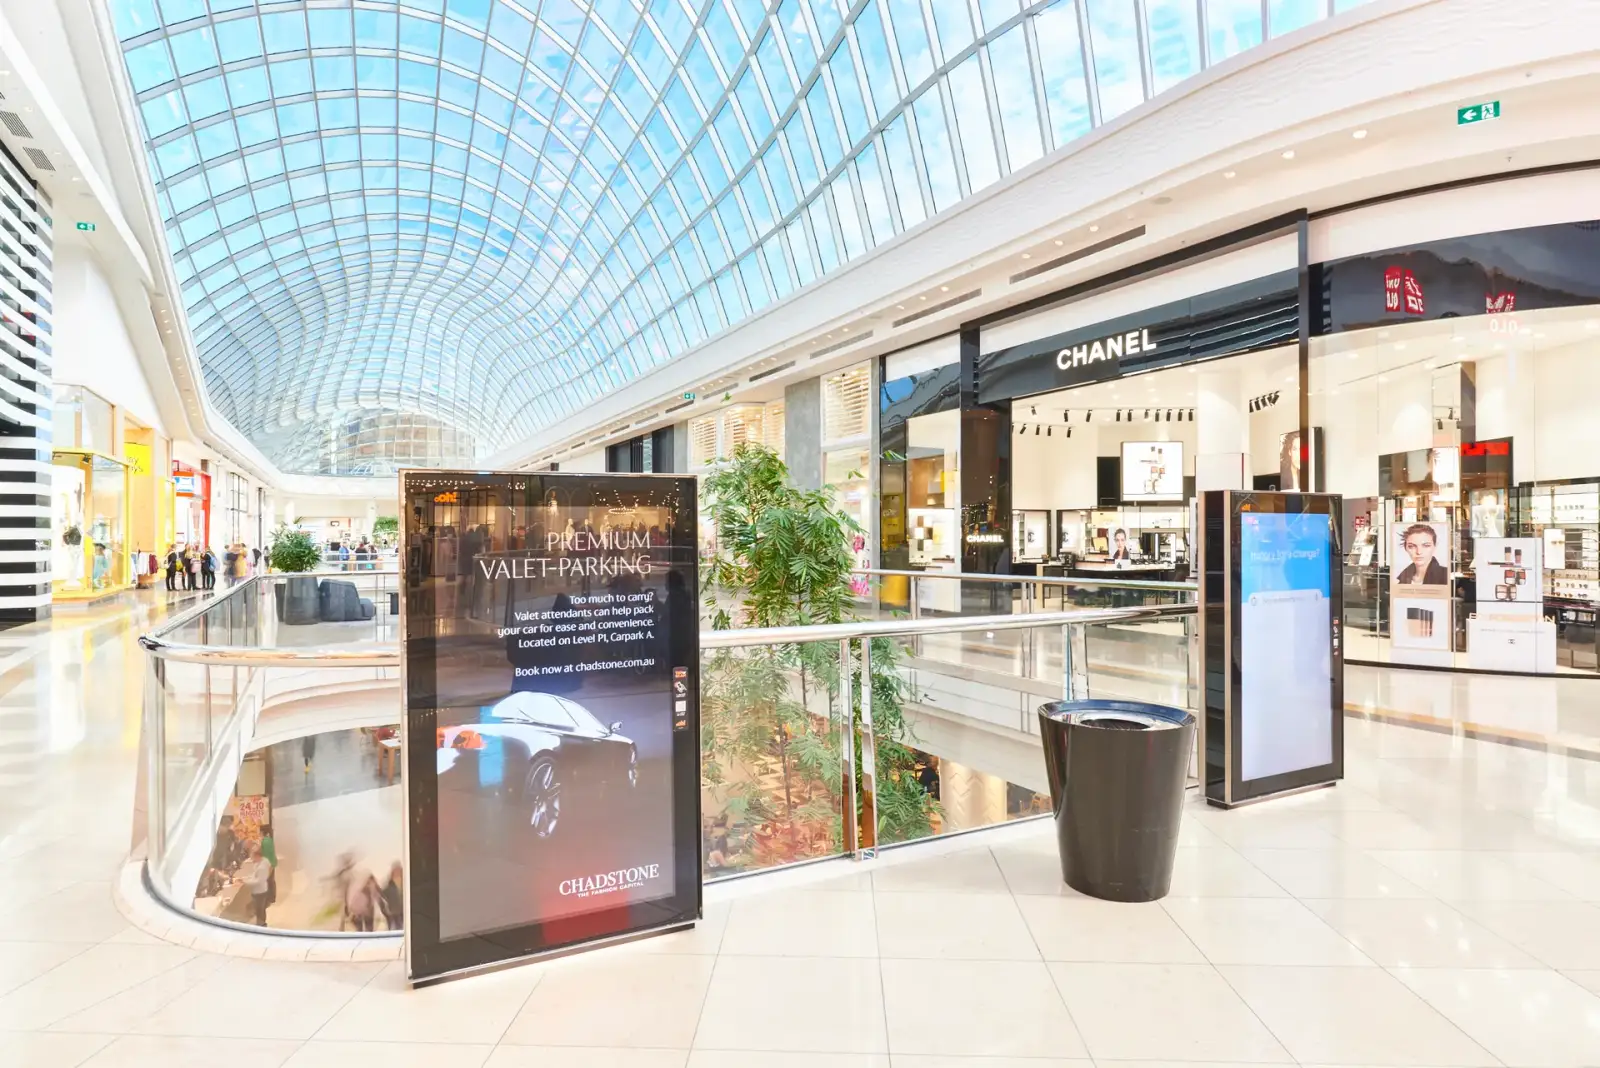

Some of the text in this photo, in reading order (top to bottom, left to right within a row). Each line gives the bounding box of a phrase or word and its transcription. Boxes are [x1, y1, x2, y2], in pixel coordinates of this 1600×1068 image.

[1056, 329, 1157, 370] CHANEL
[547, 531, 650, 551] PREMIUM
[966, 534, 1004, 543] CHANEL
[569, 592, 654, 604] Too much to carry?
[514, 605, 654, 621] Valet attendants can help pack
[497, 618, 654, 638] your car for ease and convenience.
[518, 637, 556, 648] Located
[558, 637, 571, 646] on
[573, 633, 596, 645] Level
[610, 631, 644, 644] Carpark
[646, 631, 654, 639] A.
[515, 658, 655, 677] Book now at chadstone.com.au
[559, 863, 659, 896] CHADSTONE
[591, 886, 618, 896] FASHION
[619, 882, 644, 890] CAPITAL
